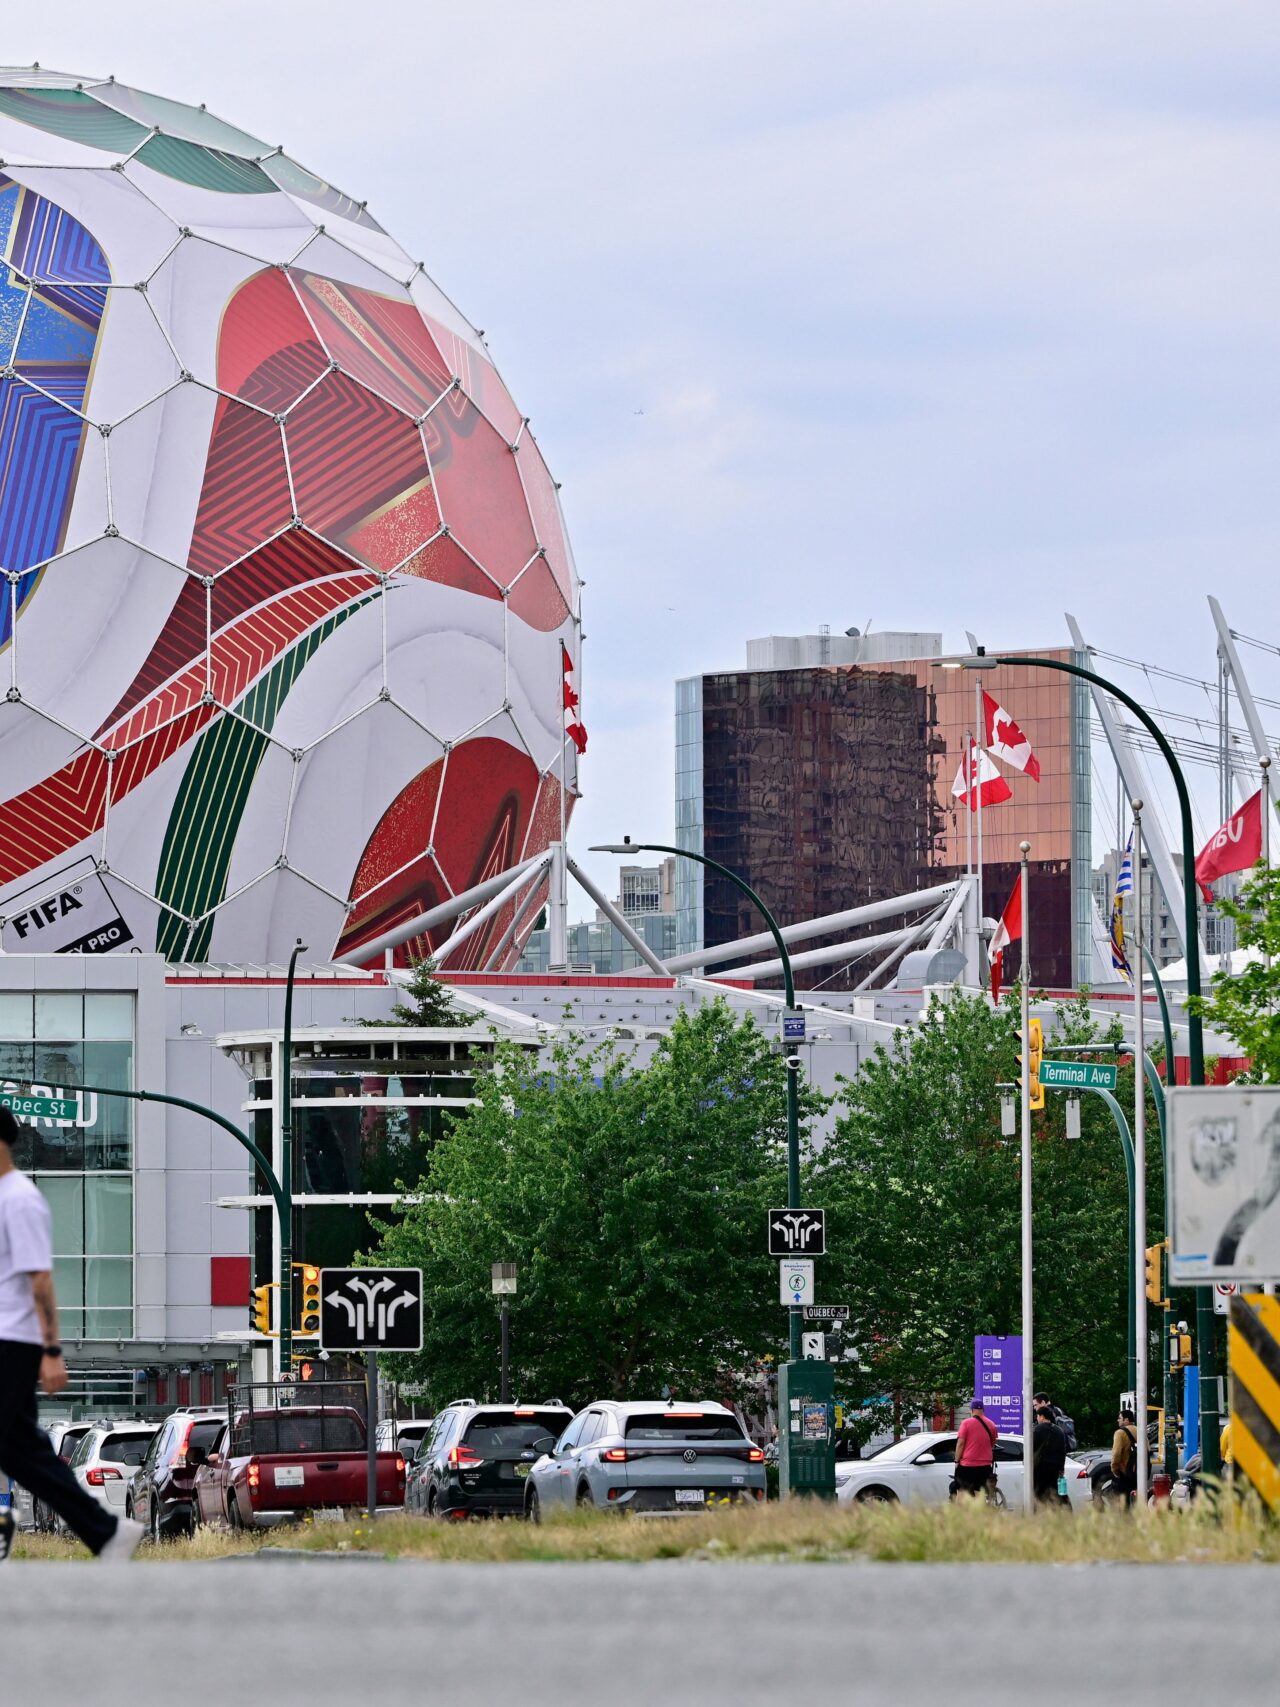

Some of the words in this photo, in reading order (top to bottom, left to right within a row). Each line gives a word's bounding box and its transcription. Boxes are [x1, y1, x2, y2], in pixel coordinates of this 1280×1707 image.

[88, 926, 121, 951] PRO
[1044, 1064, 1087, 1083] Terminal
[1091, 1067, 1111, 1084] Ave
[49, 1101, 66, 1116] St
[809, 1308, 836, 1317] QUEBEC
